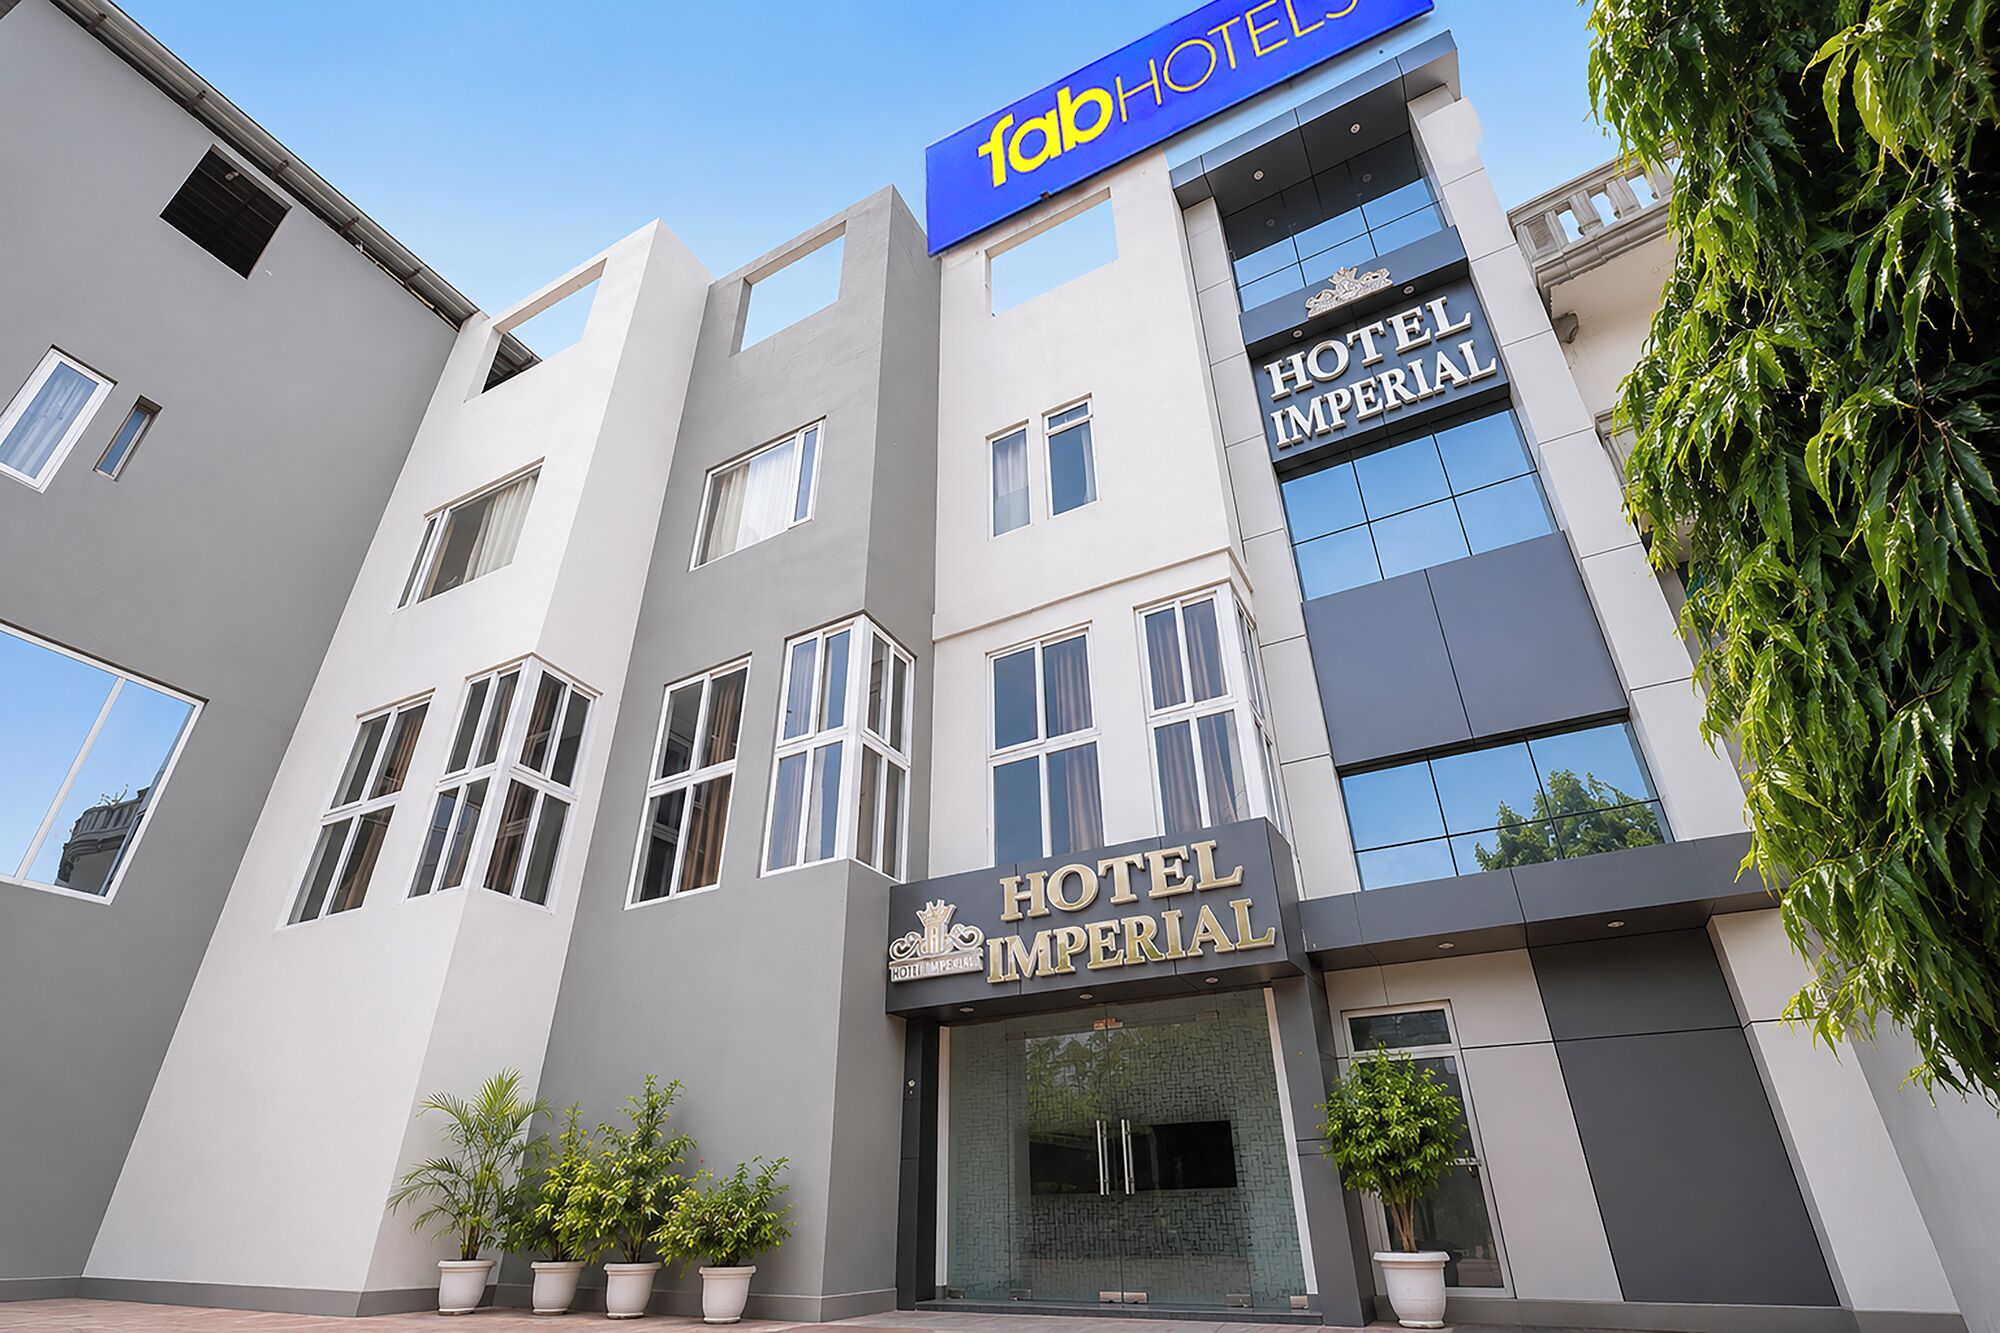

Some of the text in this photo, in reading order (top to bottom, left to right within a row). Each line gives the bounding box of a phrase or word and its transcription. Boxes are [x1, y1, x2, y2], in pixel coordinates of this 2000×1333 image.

[1264, 296, 1471, 400] HOTEL
[1270, 339, 1497, 448] IMPERIAL
[1000, 840, 1244, 921] HOTEL
[986, 898, 1276, 984] IMPERIAL
